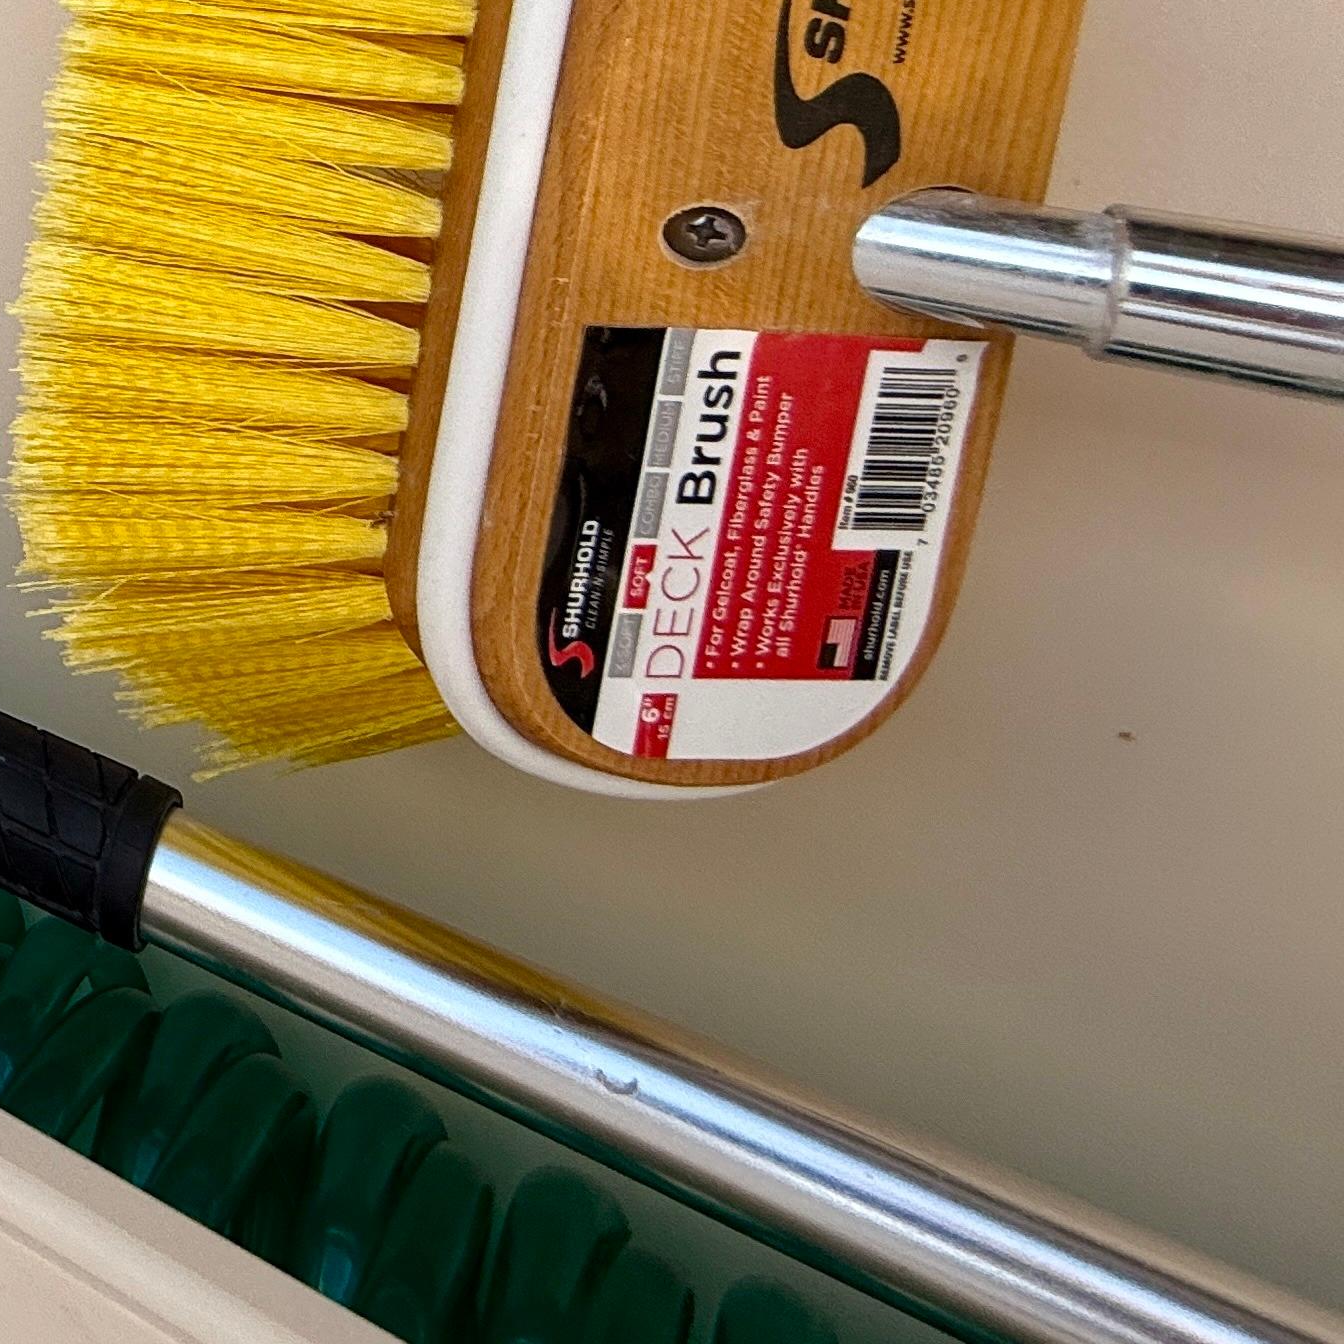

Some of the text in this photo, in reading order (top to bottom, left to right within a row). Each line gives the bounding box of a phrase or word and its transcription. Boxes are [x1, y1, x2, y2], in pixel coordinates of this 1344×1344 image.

[561, 519, 600, 639] SHURHOLD
[631, 556, 648, 597] SOFT
[645, 350, 742, 679] DECK Brush
[704, 375, 773, 657] For Gelcoat, Fiberglass & Paint
[730, 392, 795, 657] Wrap Around Safety Bumper
[755, 447, 810, 656] Works Exclusively with
[775, 636, 792, 658] all
[796, 465, 825, 539] Handles
[916, 538, 928, 547] 7
[863, 569, 891, 661] shurhold.com
[657, 697, 675, 739] 15 cm
